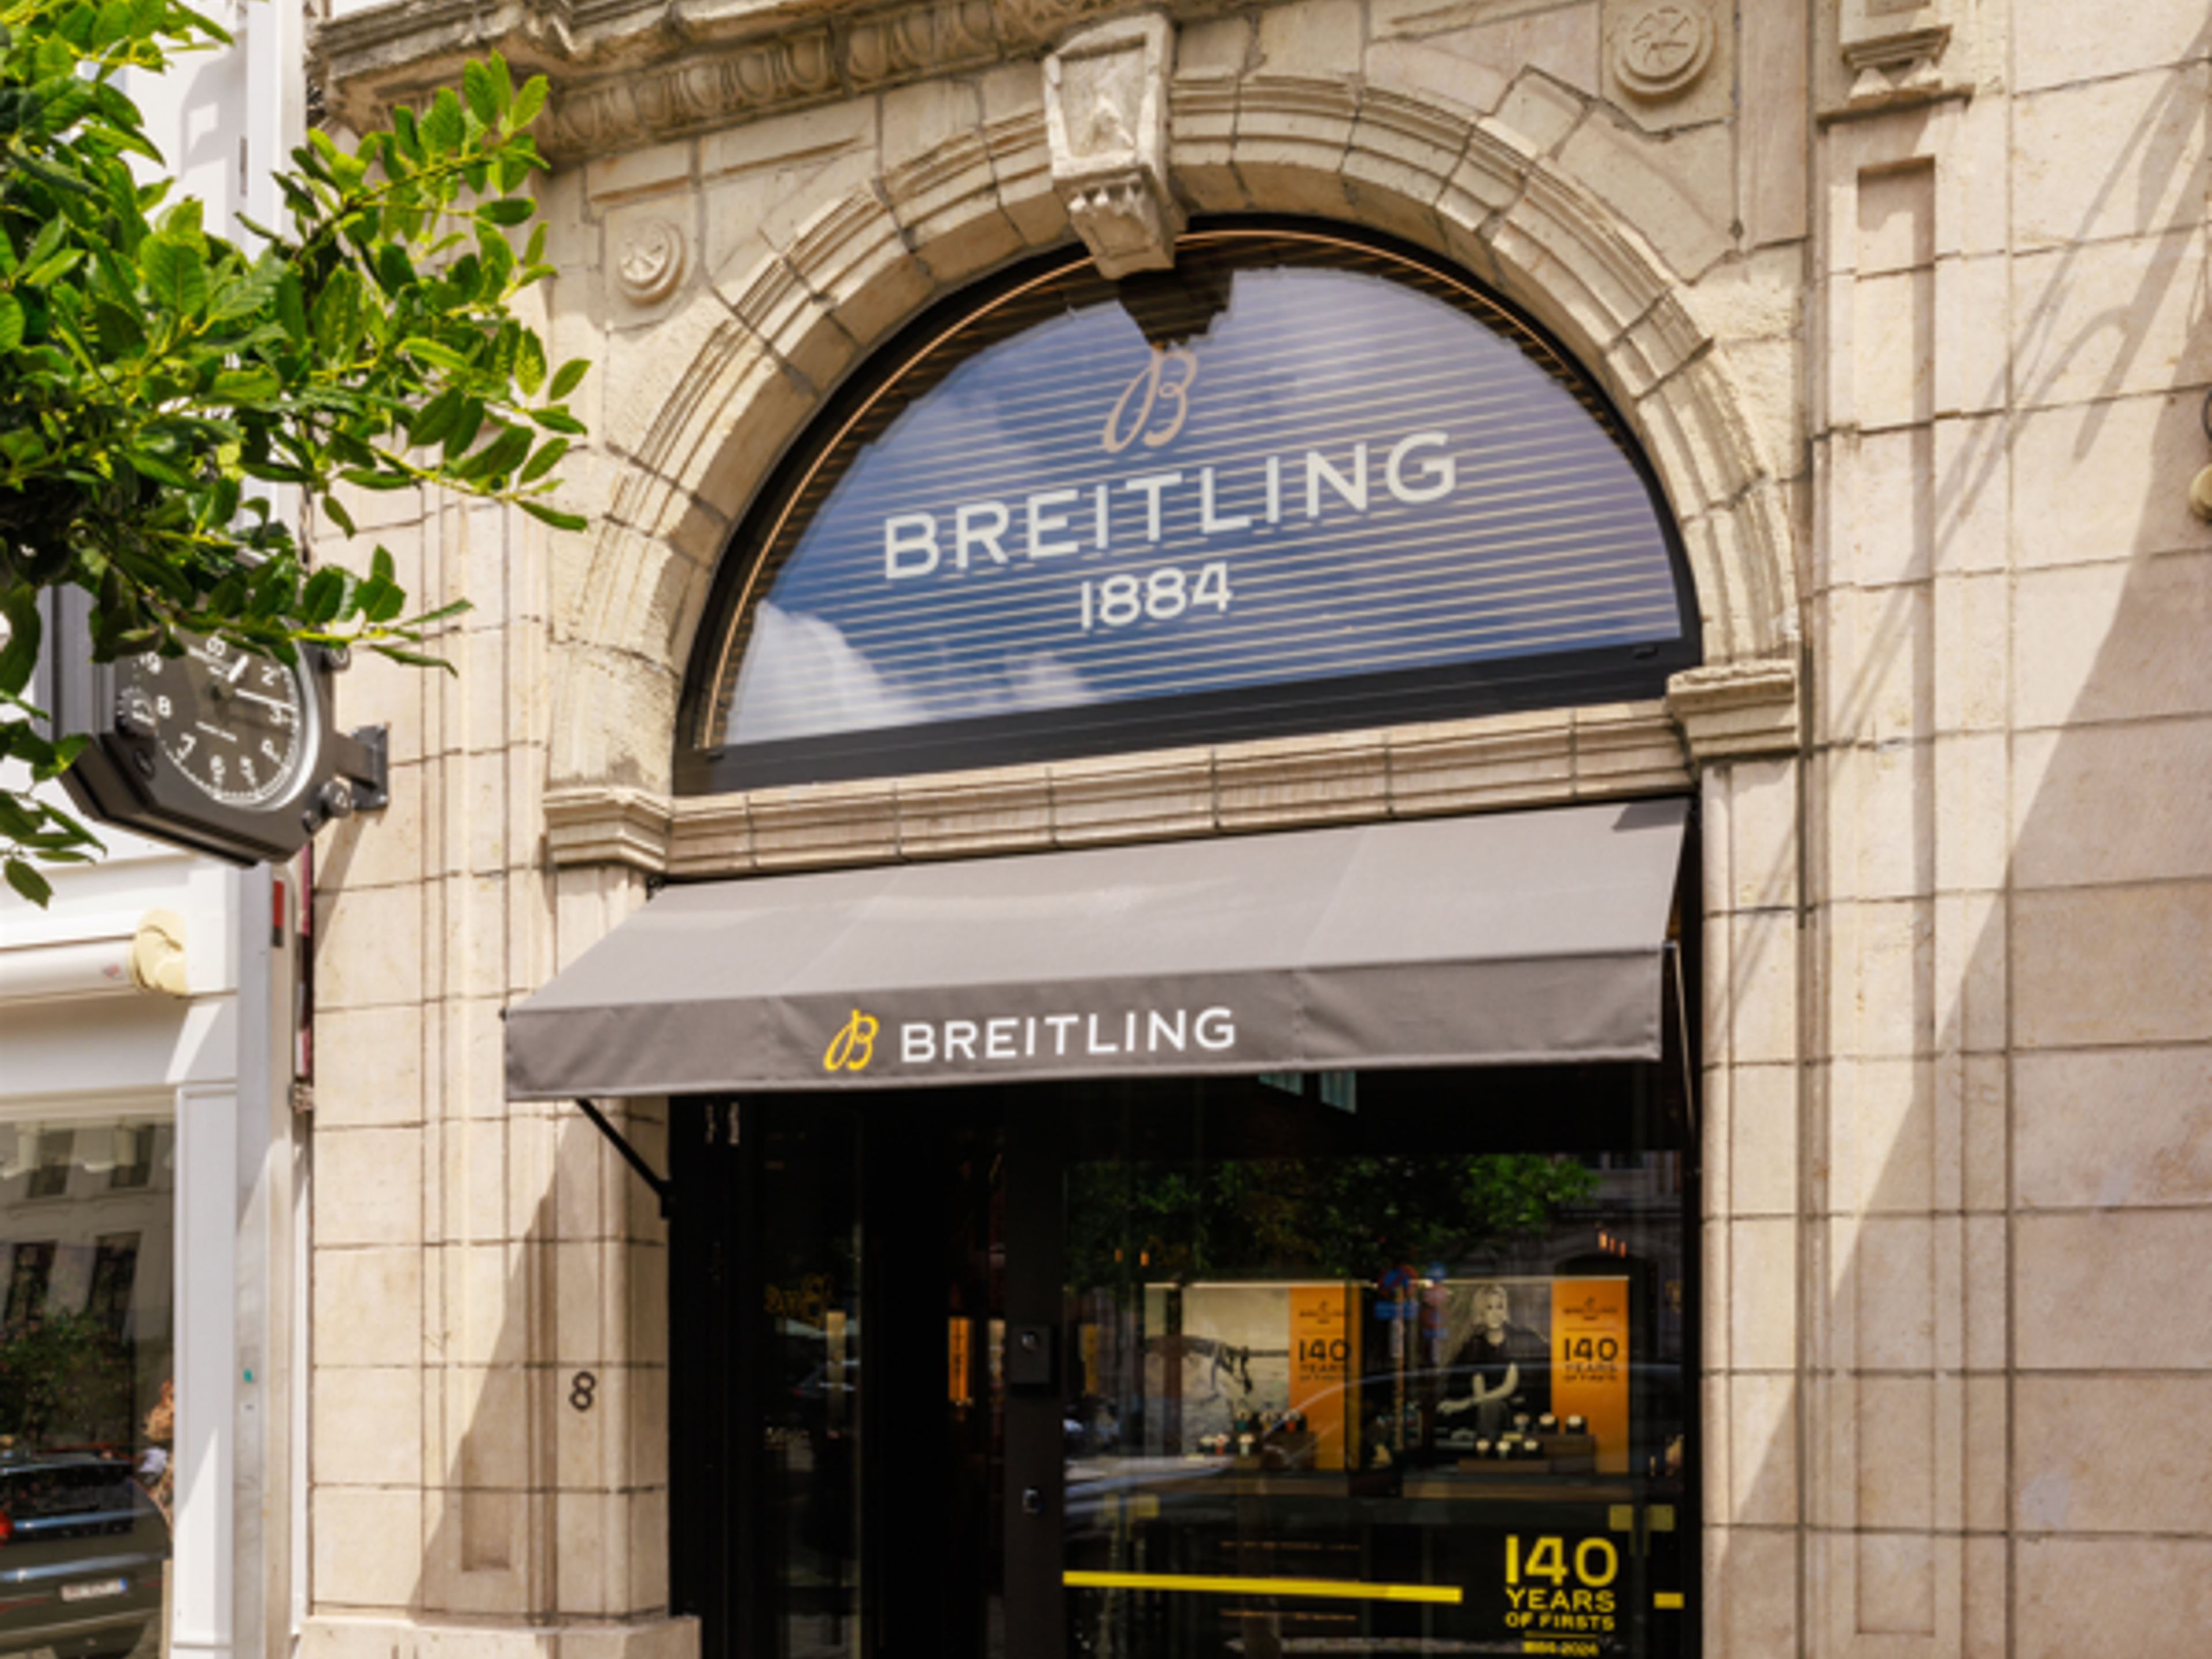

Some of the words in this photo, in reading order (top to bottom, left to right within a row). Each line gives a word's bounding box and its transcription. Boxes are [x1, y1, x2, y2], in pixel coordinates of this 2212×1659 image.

[885, 431, 1456, 579] BREITLING
[1081, 561, 1233, 630] 1884
[158, 695, 171, 718] 8
[901, 1006, 1235, 1062] BREITLING
[1300, 1338, 1351, 1362] 140
[1564, 1338, 1618, 1362] 140
[568, 1371, 595, 1411] 8
[1505, 1535, 1619, 1586] 140
[1505, 1586, 1615, 1613] YEARS
[1505, 1611, 1533, 1628] OF
[1539, 1612, 1615, 1631] FIRSTS
